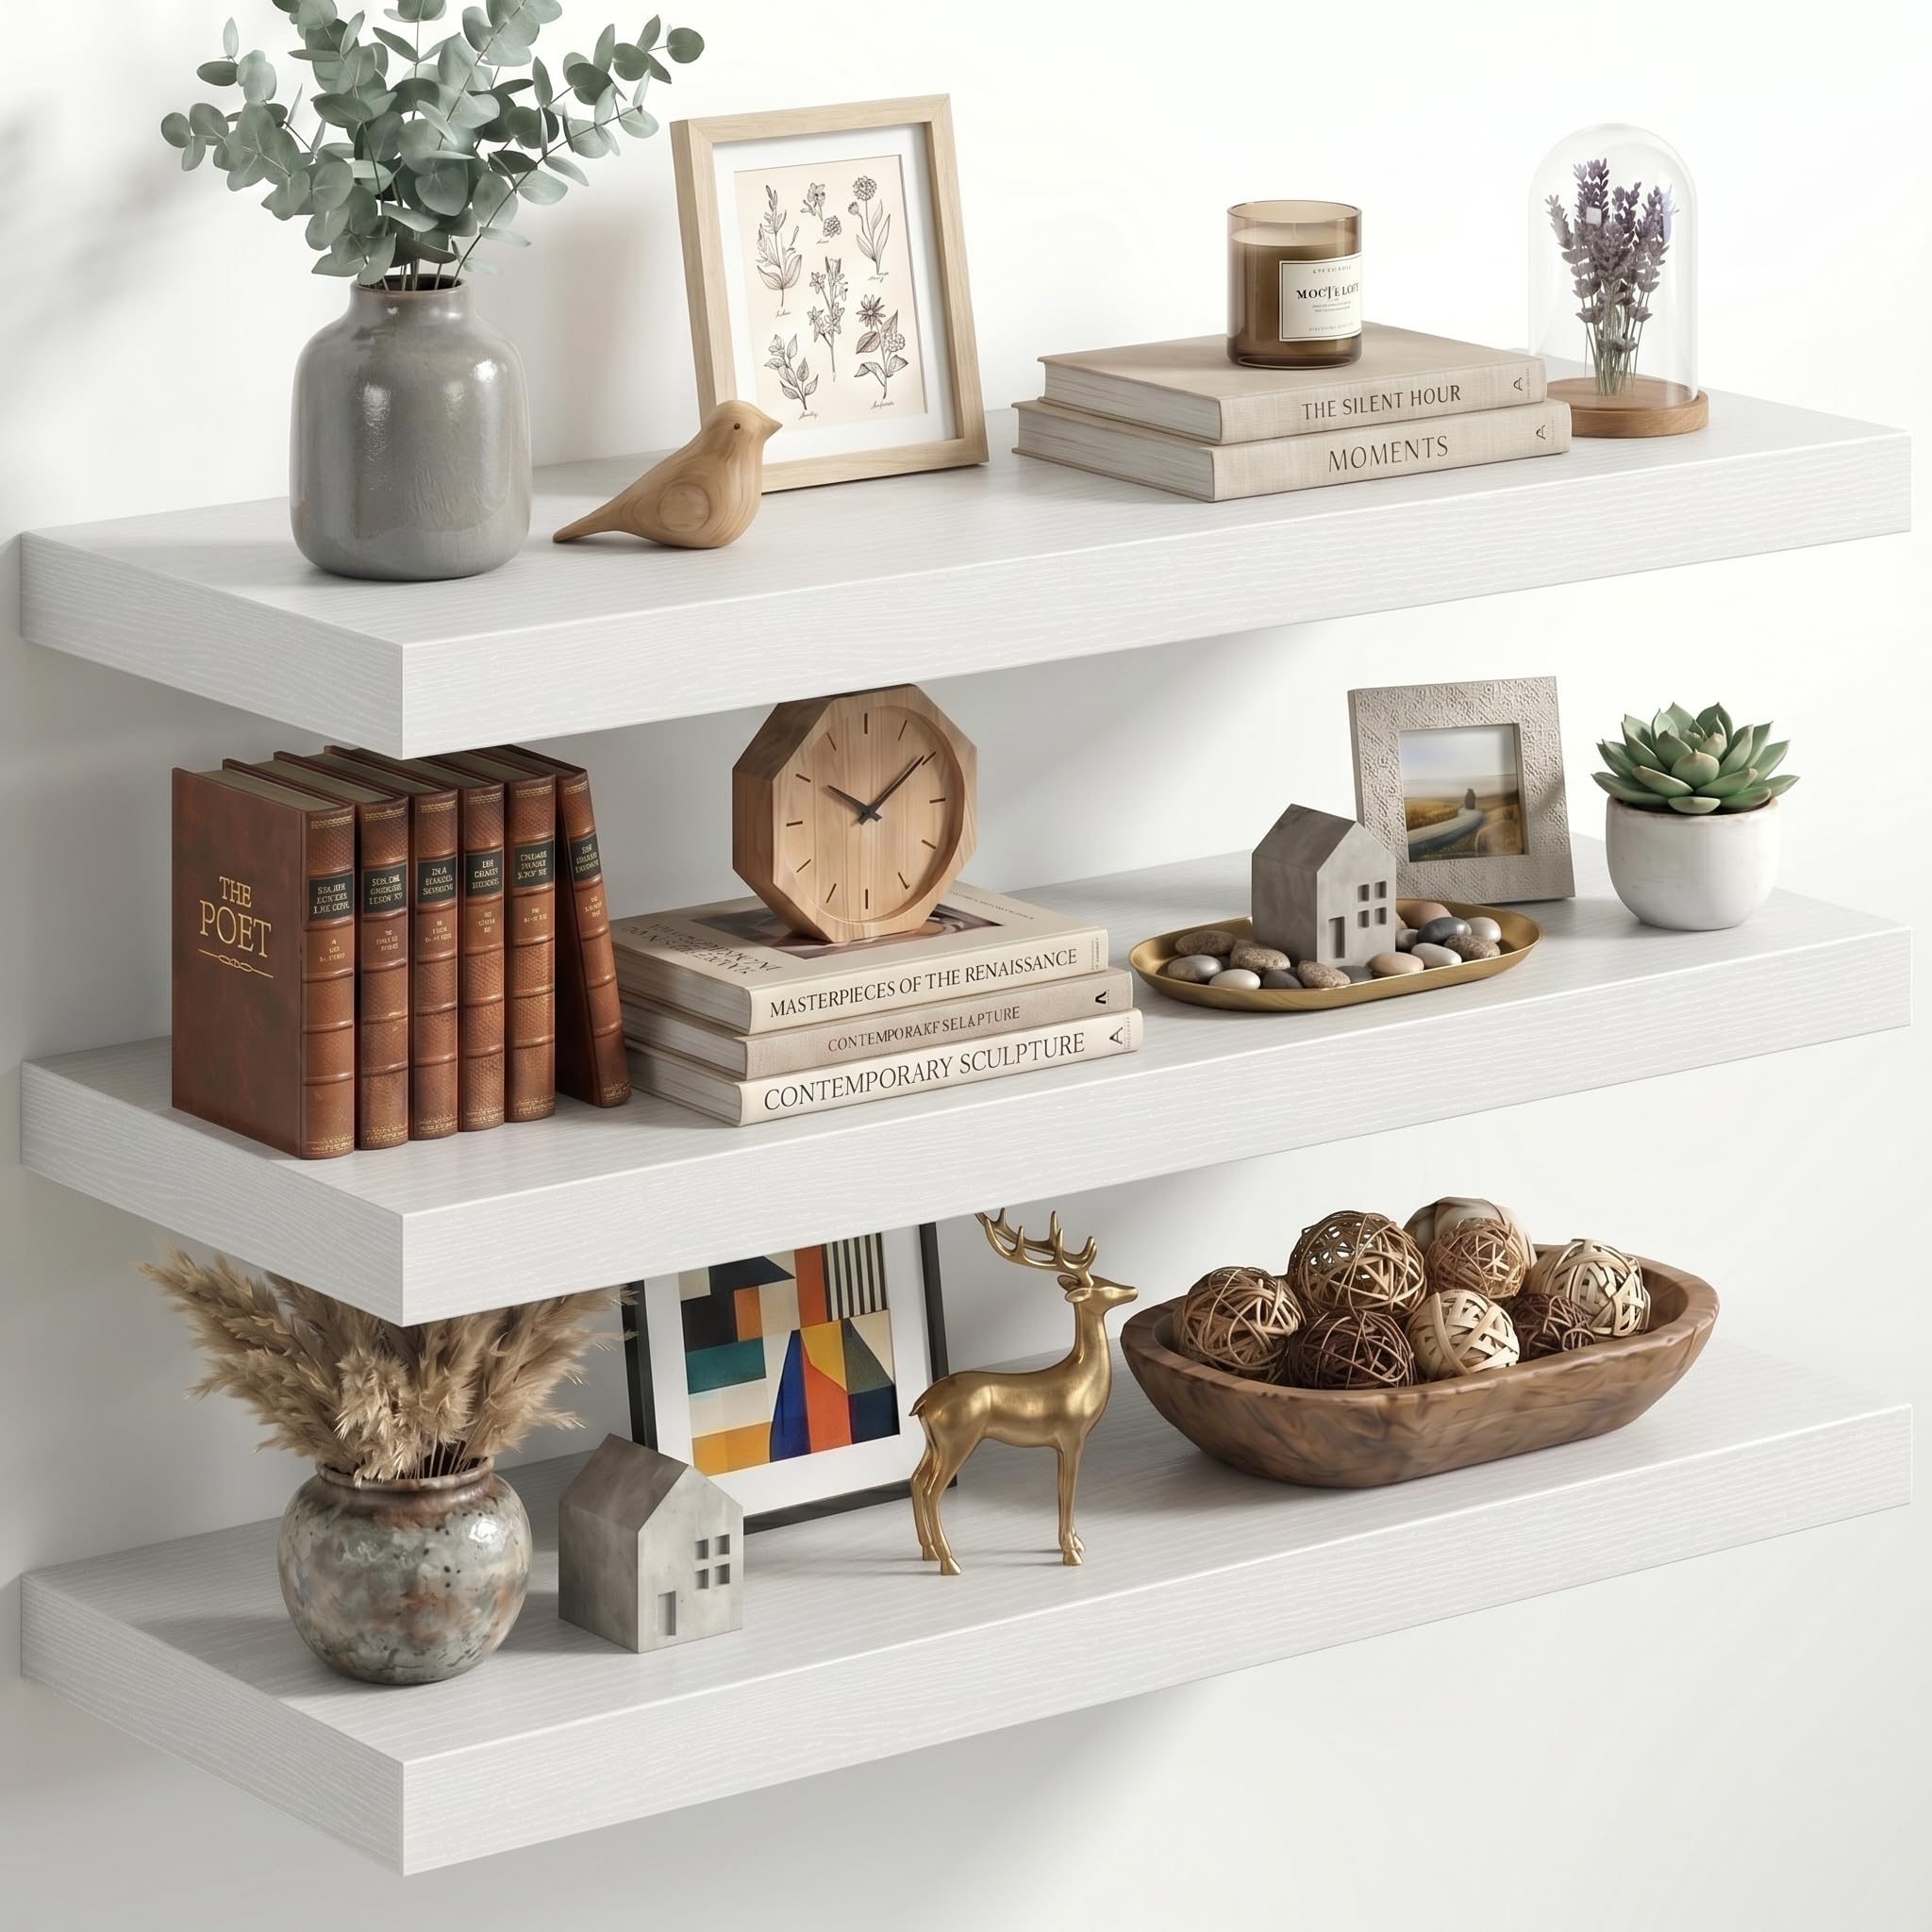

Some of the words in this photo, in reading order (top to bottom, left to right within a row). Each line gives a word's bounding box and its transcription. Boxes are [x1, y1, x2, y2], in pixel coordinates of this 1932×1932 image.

[1302, 400, 1337, 421] THE
[1342, 391, 1404, 416] SILENT
[1410, 385, 1461, 407] HOUR
[1328, 435, 1448, 473] MOMENTS
[219, 875, 252, 908] THE
[199, 900, 272, 958] POET
[770, 980, 895, 1018] MASTERPIECES
[899, 975, 922, 994] OF
[925, 969, 960, 990] THE
[965, 948, 1077, 983] RENAISSANCE
[764, 1056, 954, 1110] CONTEMPORARY
[959, 1032, 1085, 1074] SCULPTURE
